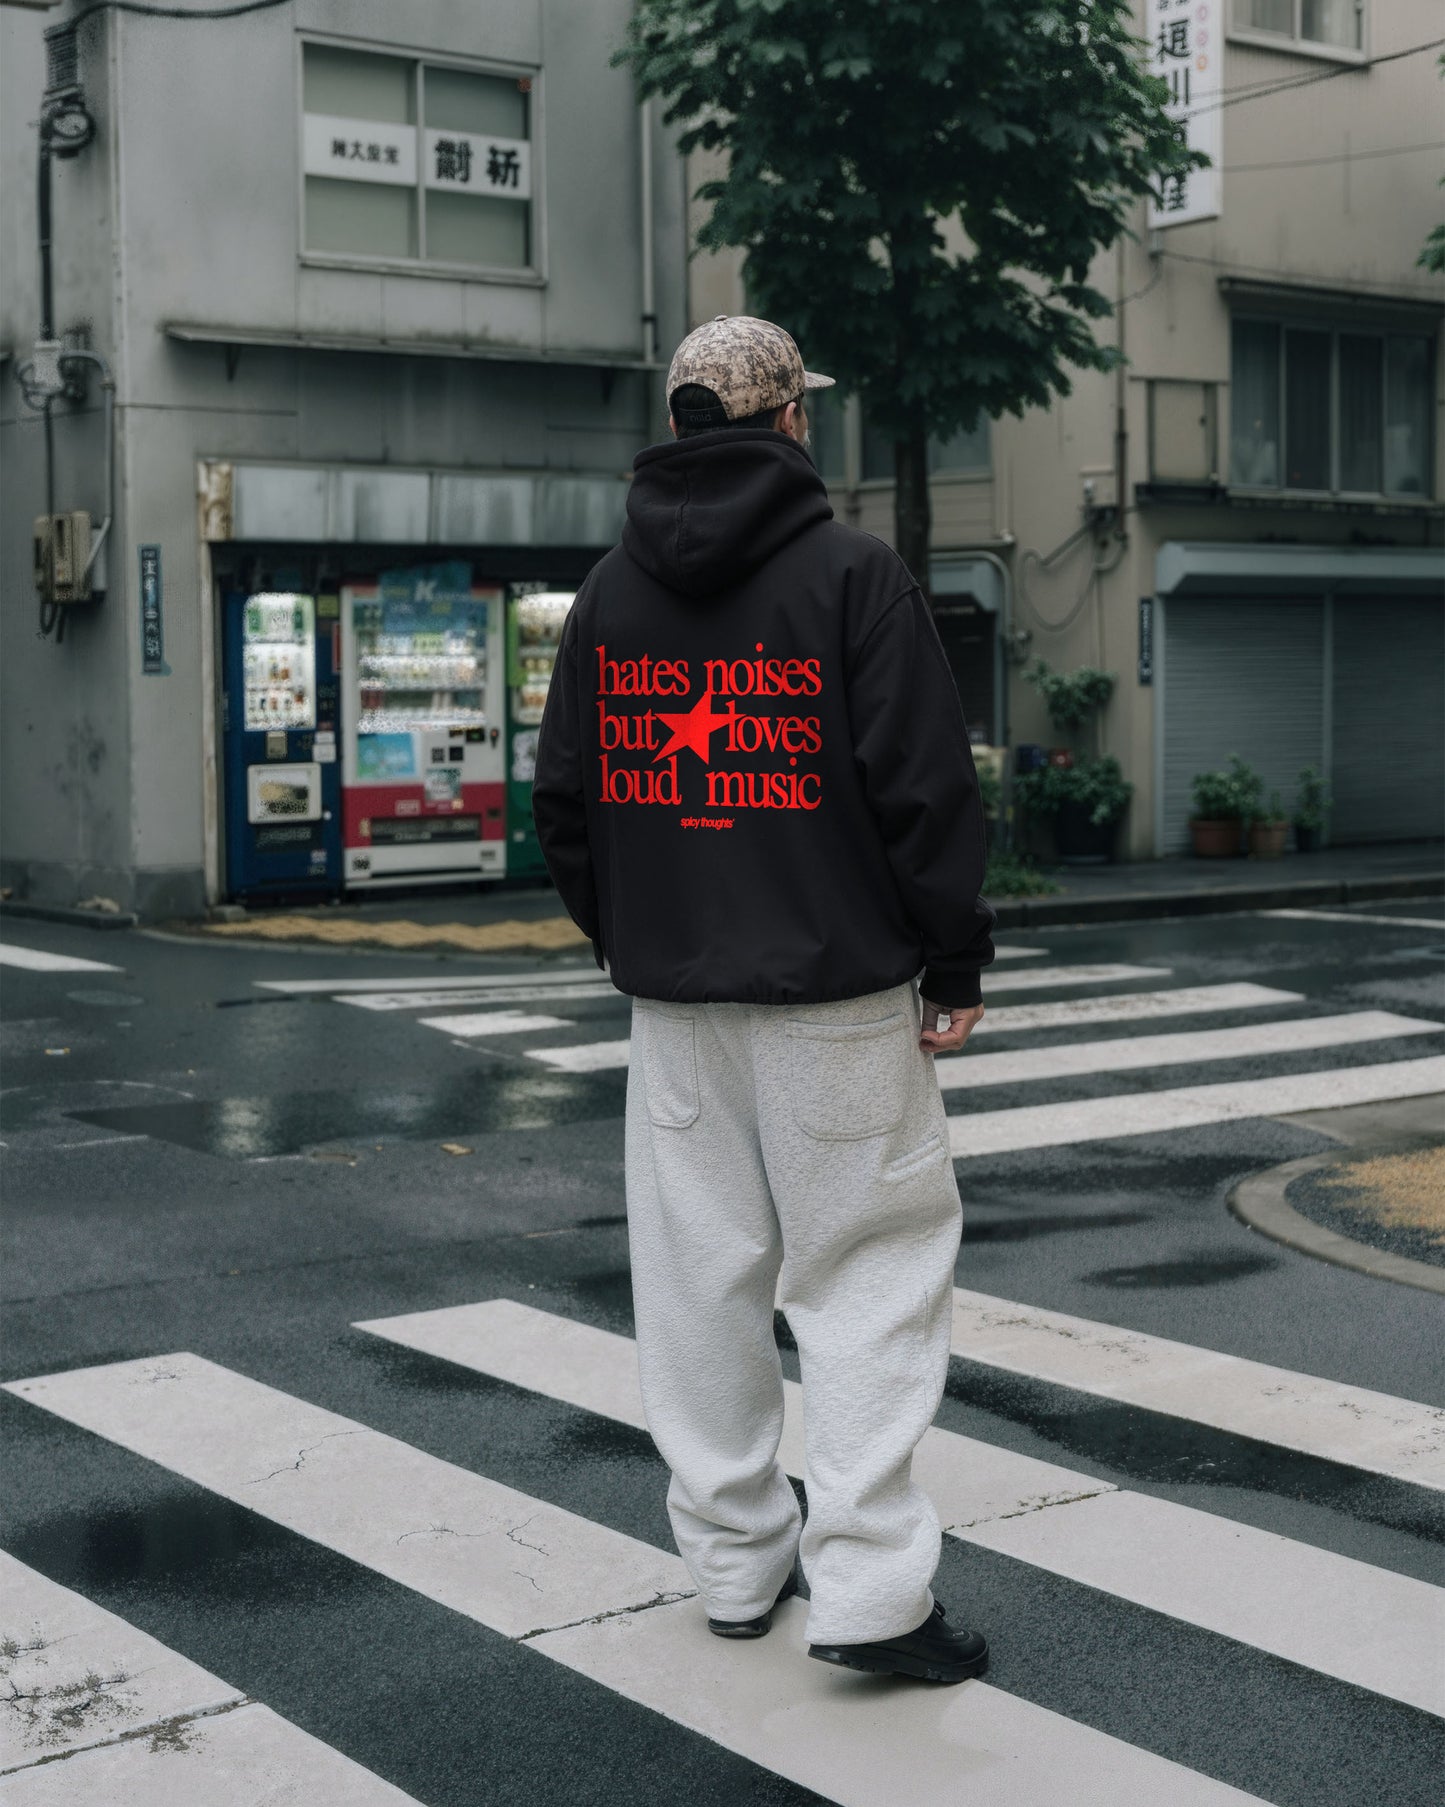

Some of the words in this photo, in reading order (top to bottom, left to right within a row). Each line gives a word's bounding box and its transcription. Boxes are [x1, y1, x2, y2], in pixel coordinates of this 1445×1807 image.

[595, 644, 691, 696] hates
[703, 642, 823, 697] noises
[597, 699, 659, 750] but
[725, 699, 823, 753] loves
[598, 753, 682, 806] loud
[705, 756, 822, 810] music
[680, 816, 700, 829] spicy
